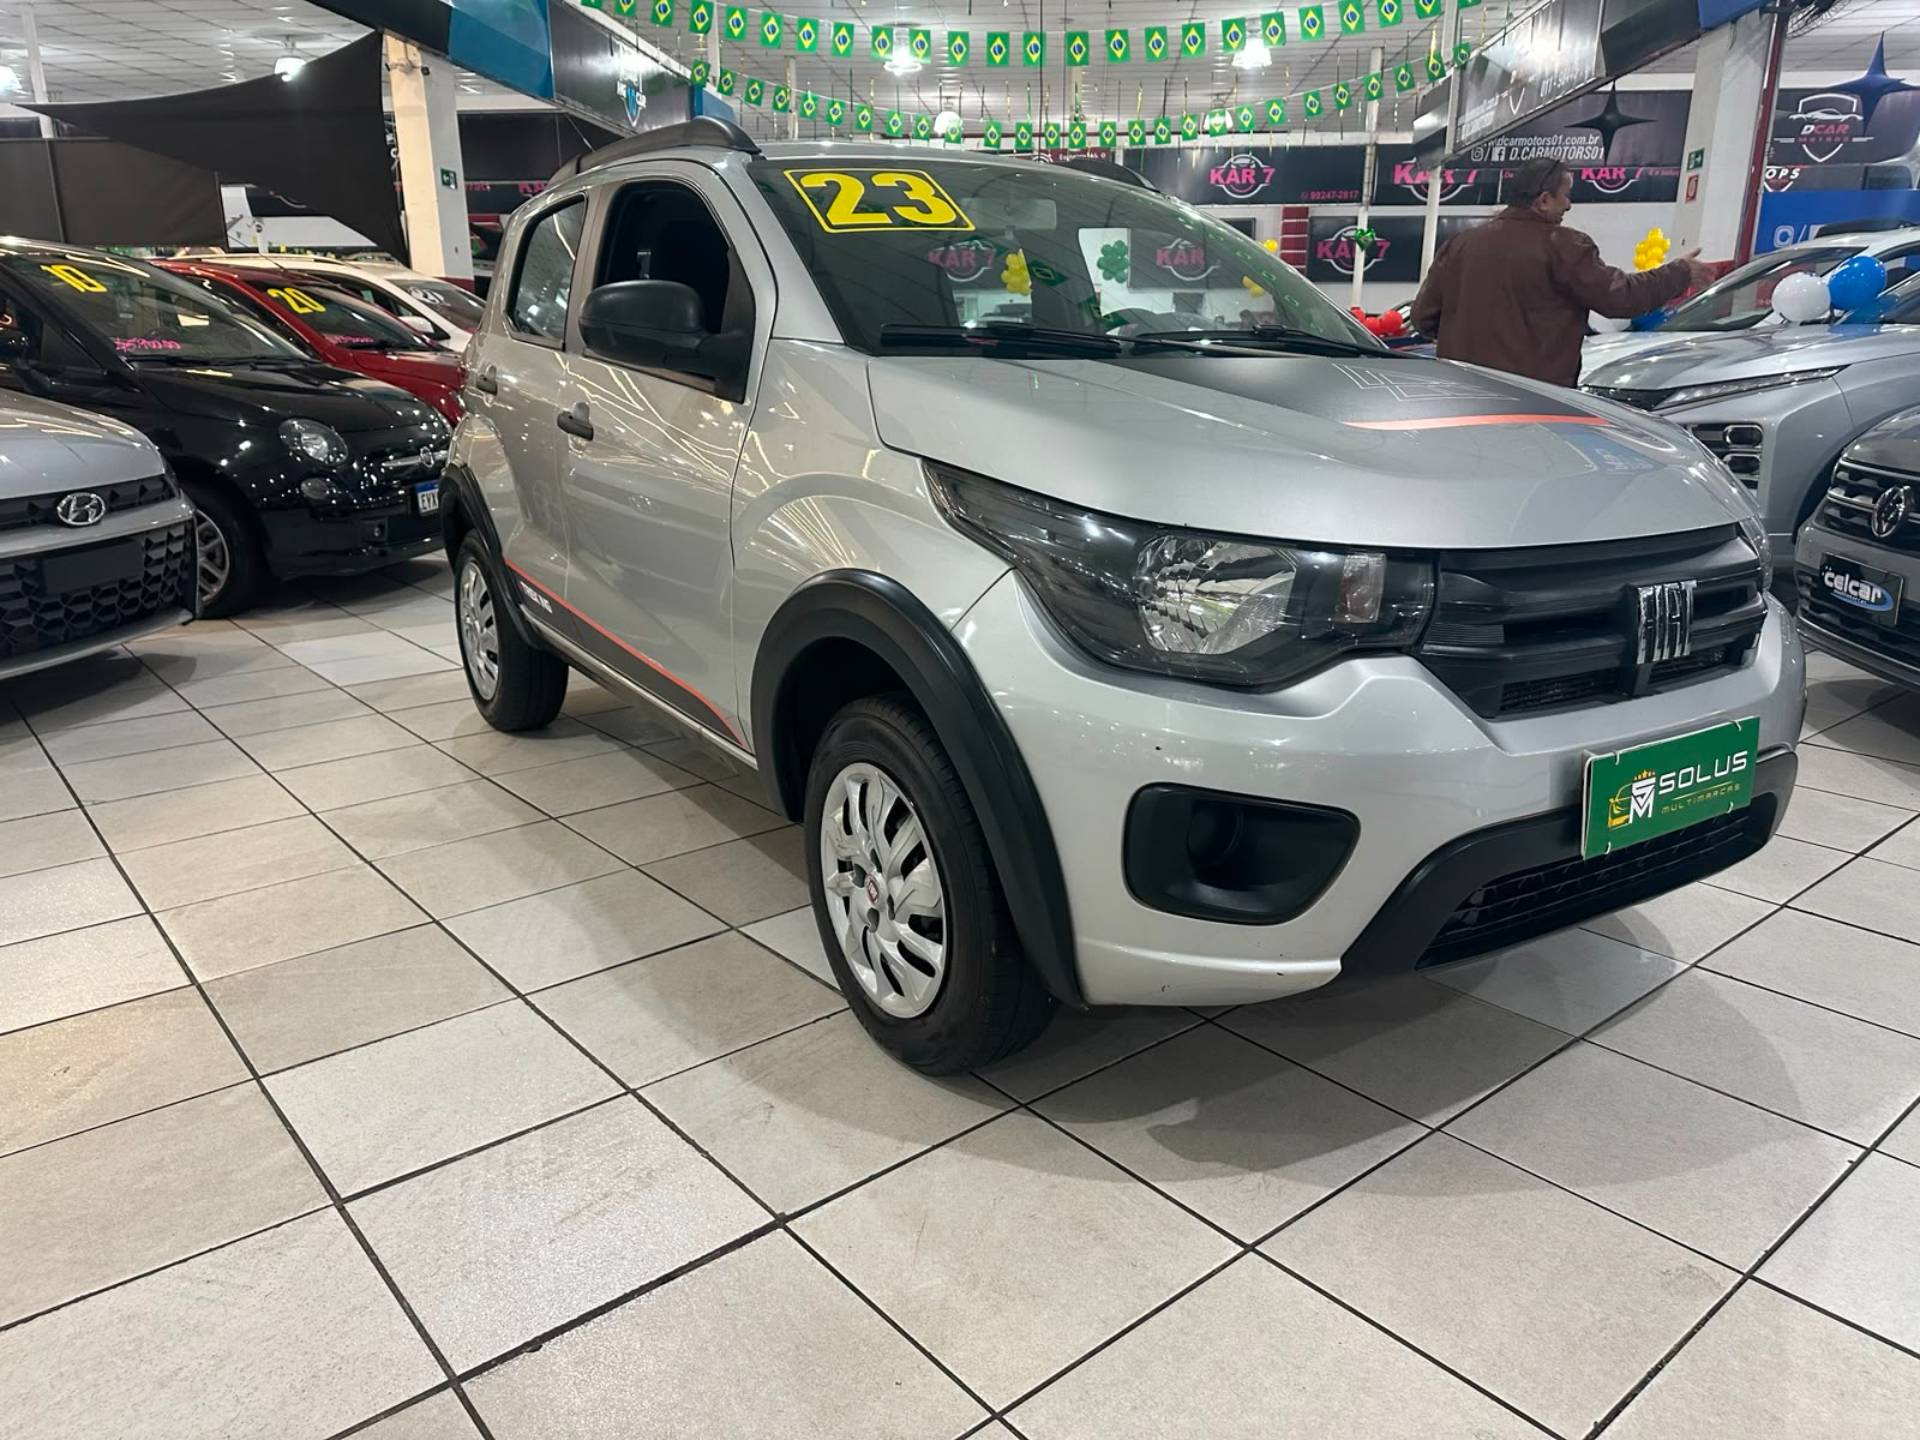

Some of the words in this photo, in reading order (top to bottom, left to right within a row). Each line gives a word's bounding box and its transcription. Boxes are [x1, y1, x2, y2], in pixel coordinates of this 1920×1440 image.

[1801, 124, 1850, 135] DCAR
[1209, 167, 1257, 185] KAR
[1262, 167, 1276, 184] 7
[800, 173, 957, 225] 23
[928, 249, 977, 268] KAR
[1376, 241, 1391, 258] 7
[40, 264, 108, 293] 10
[266, 287, 327, 314] 20
[1823, 569, 1882, 603] celcar
[1658, 750, 1748, 796] SOLUS
[1661, 783, 1741, 815] MULTIMARCAS
